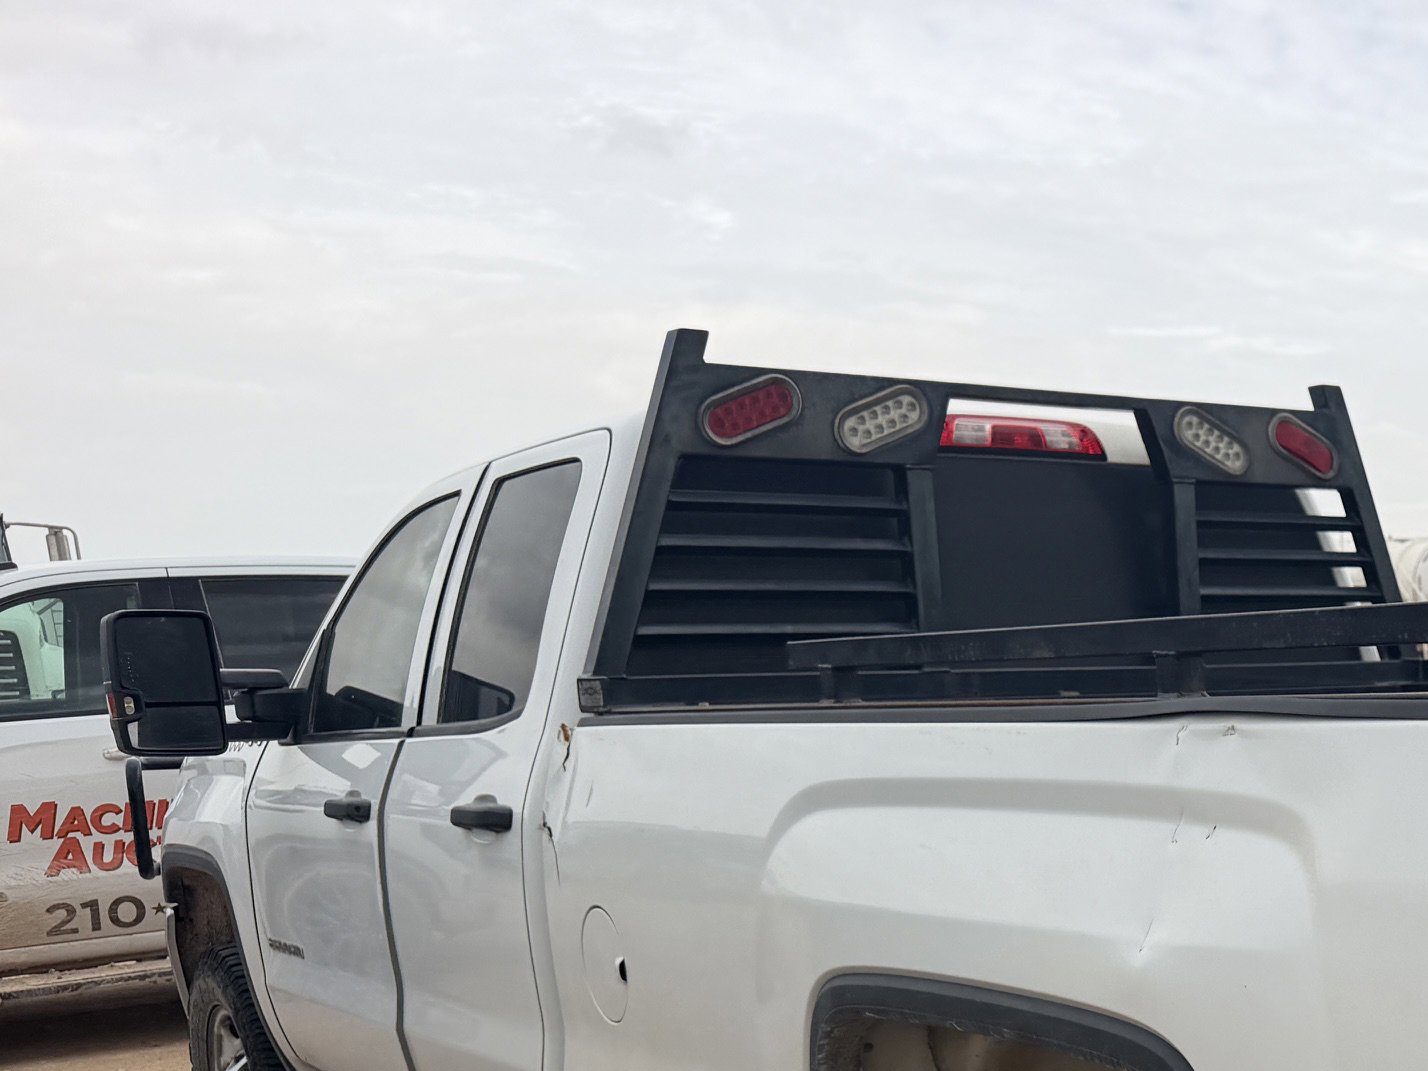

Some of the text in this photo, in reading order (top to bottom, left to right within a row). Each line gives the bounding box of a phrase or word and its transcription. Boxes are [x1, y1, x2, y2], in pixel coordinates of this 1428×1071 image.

[7, 798, 173, 843] MACHI
[44, 836, 162, 877] AUC
[46, 895, 147, 937] 210
